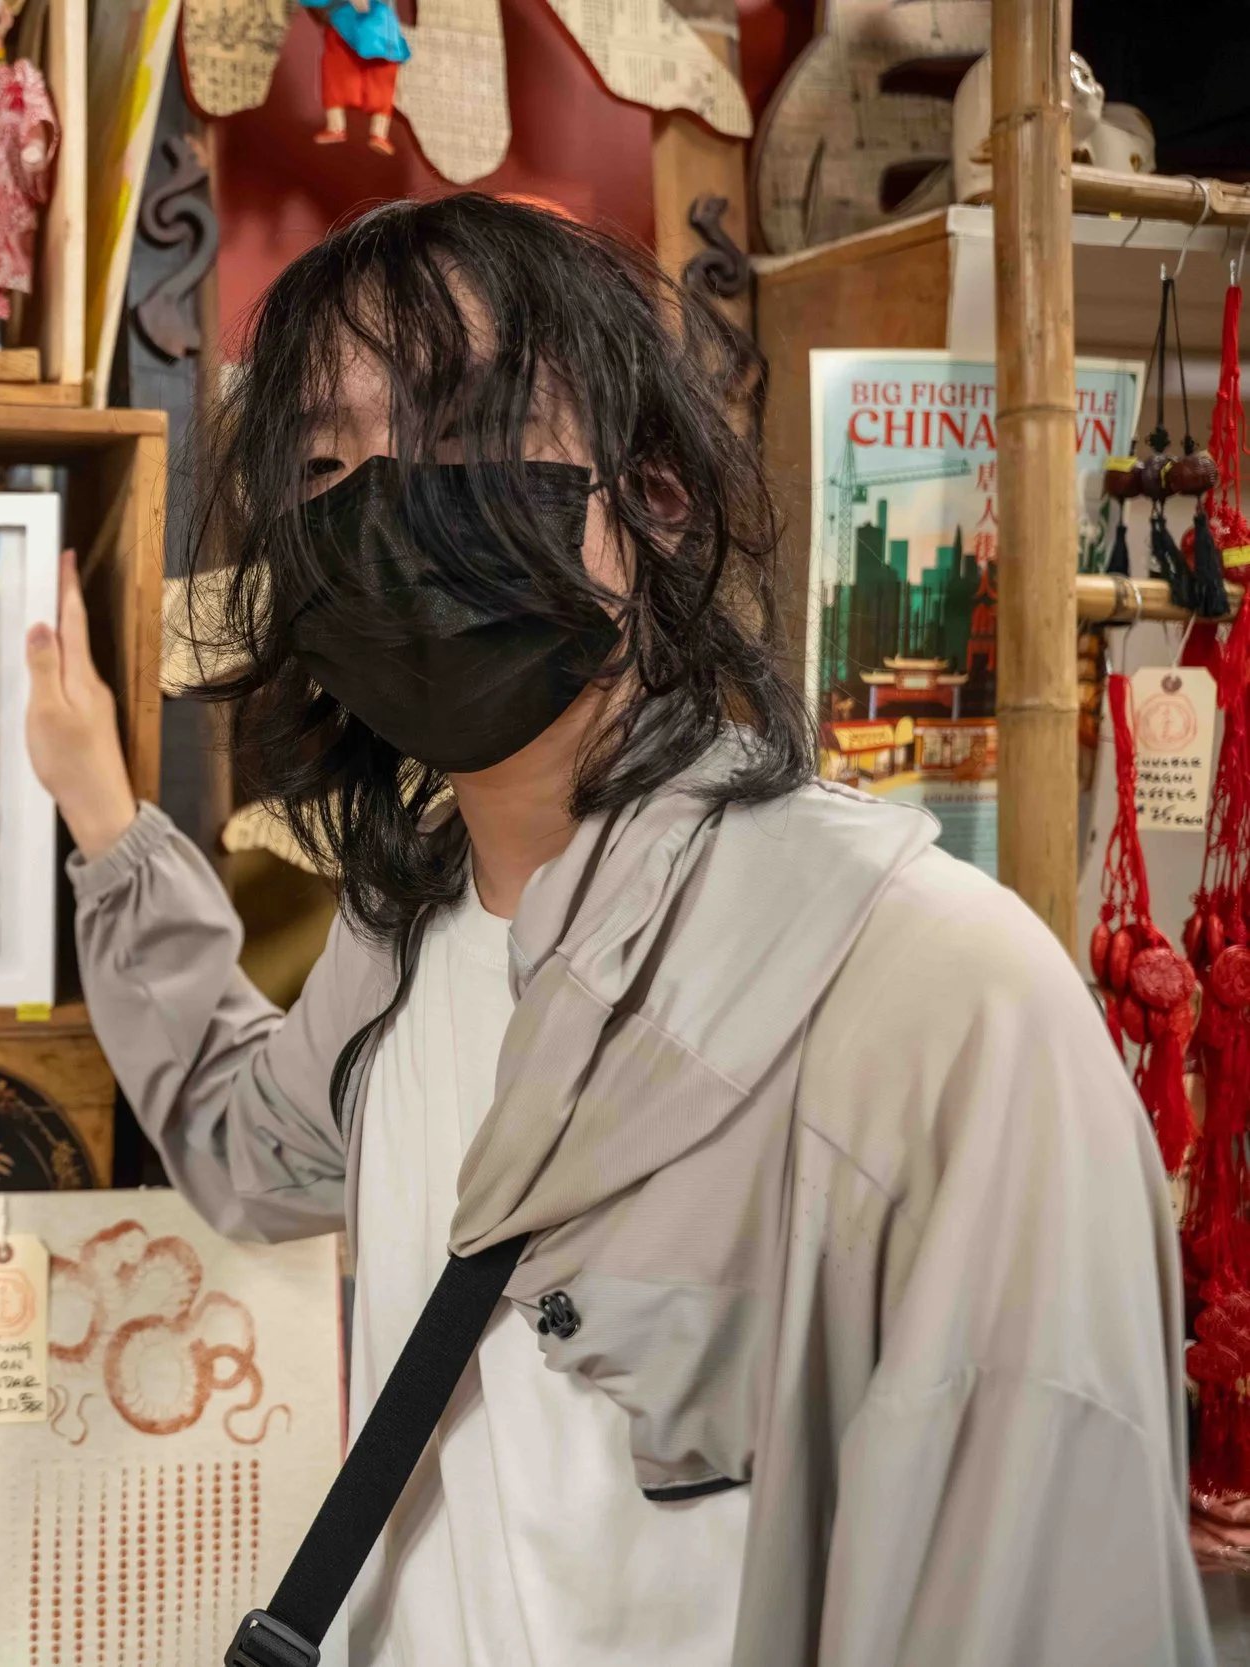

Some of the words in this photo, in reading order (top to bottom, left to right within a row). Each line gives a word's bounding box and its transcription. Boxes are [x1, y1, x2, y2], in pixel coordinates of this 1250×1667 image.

[851, 381, 901, 406] BIG
[911, 382, 996, 409] FIGHT
[847, 408, 1117, 456] CHINAN
